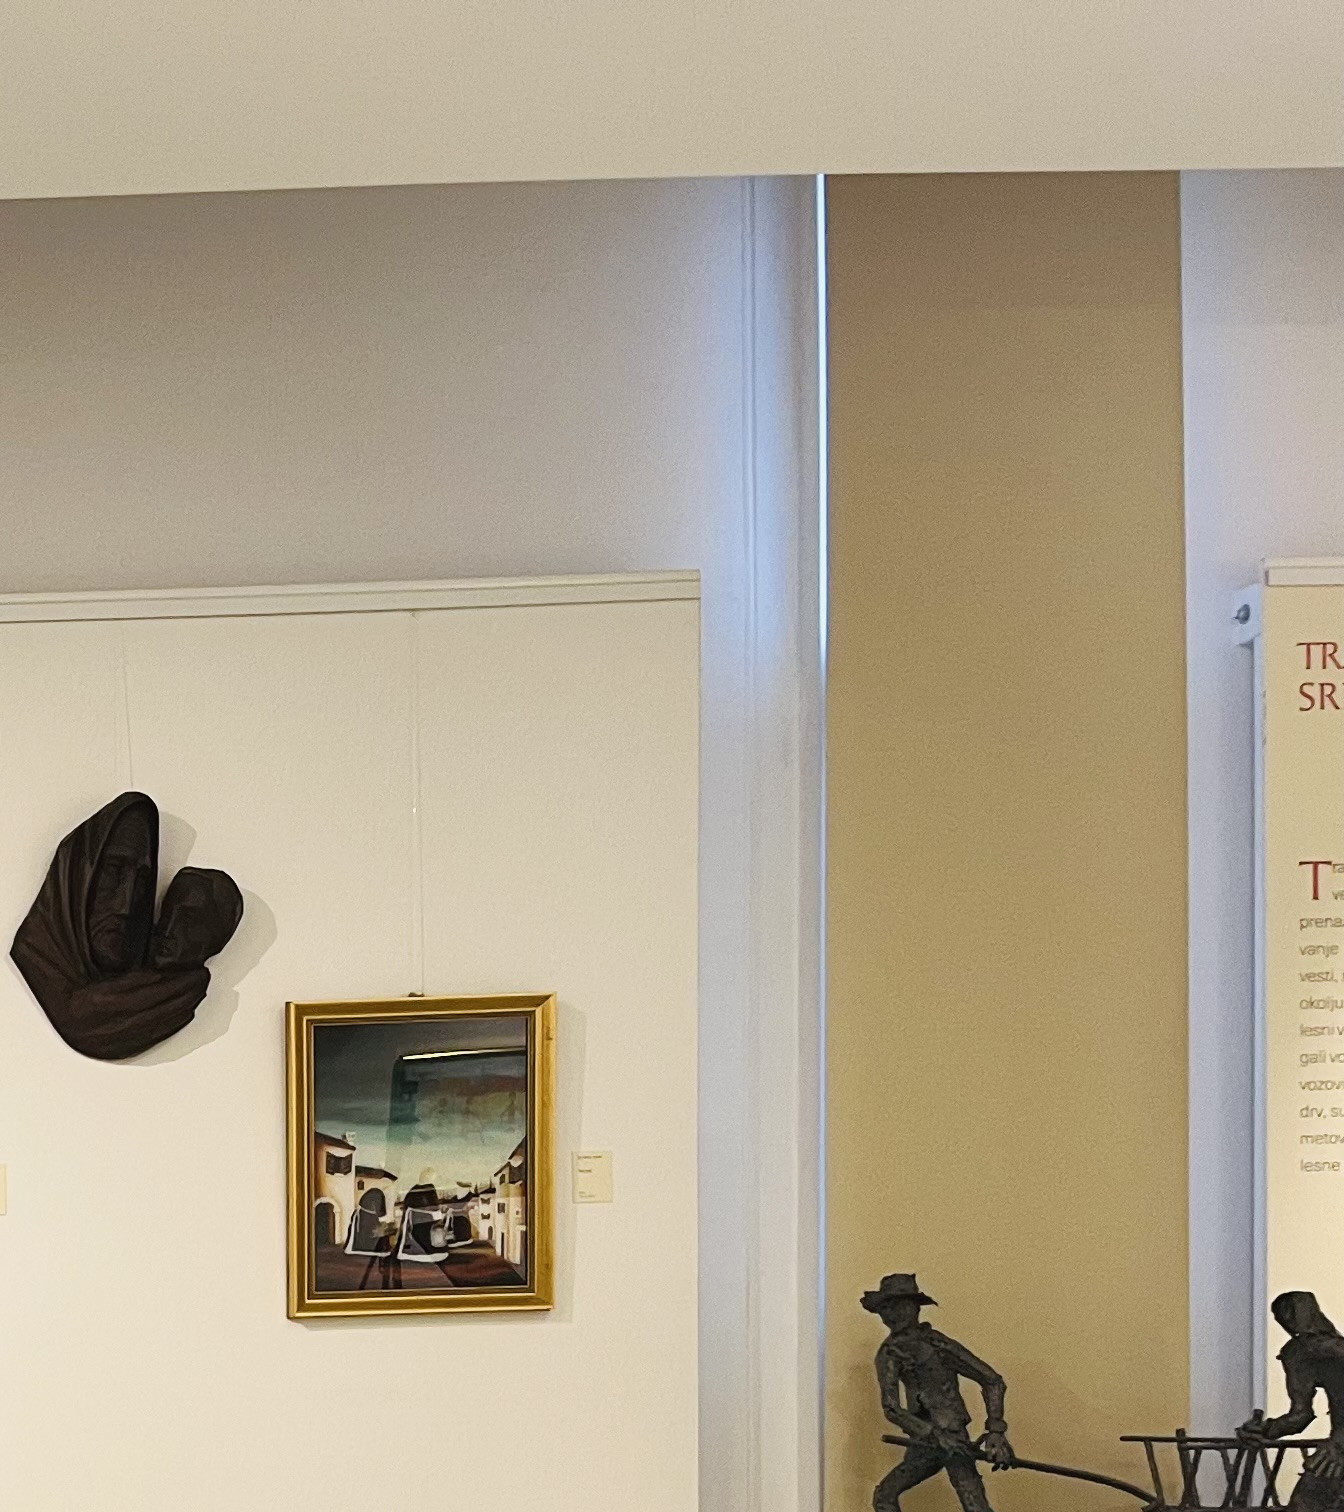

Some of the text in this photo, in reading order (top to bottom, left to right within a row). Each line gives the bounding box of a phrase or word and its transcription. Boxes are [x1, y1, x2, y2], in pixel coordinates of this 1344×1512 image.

[1296, 642, 1344, 670] TR
[1299, 682, 1344, 711] SR
[1299, 917, 1344, 931] prena
[1299, 945, 1339, 958] vanje
[1300, 1160, 1340, 1172] lesne
